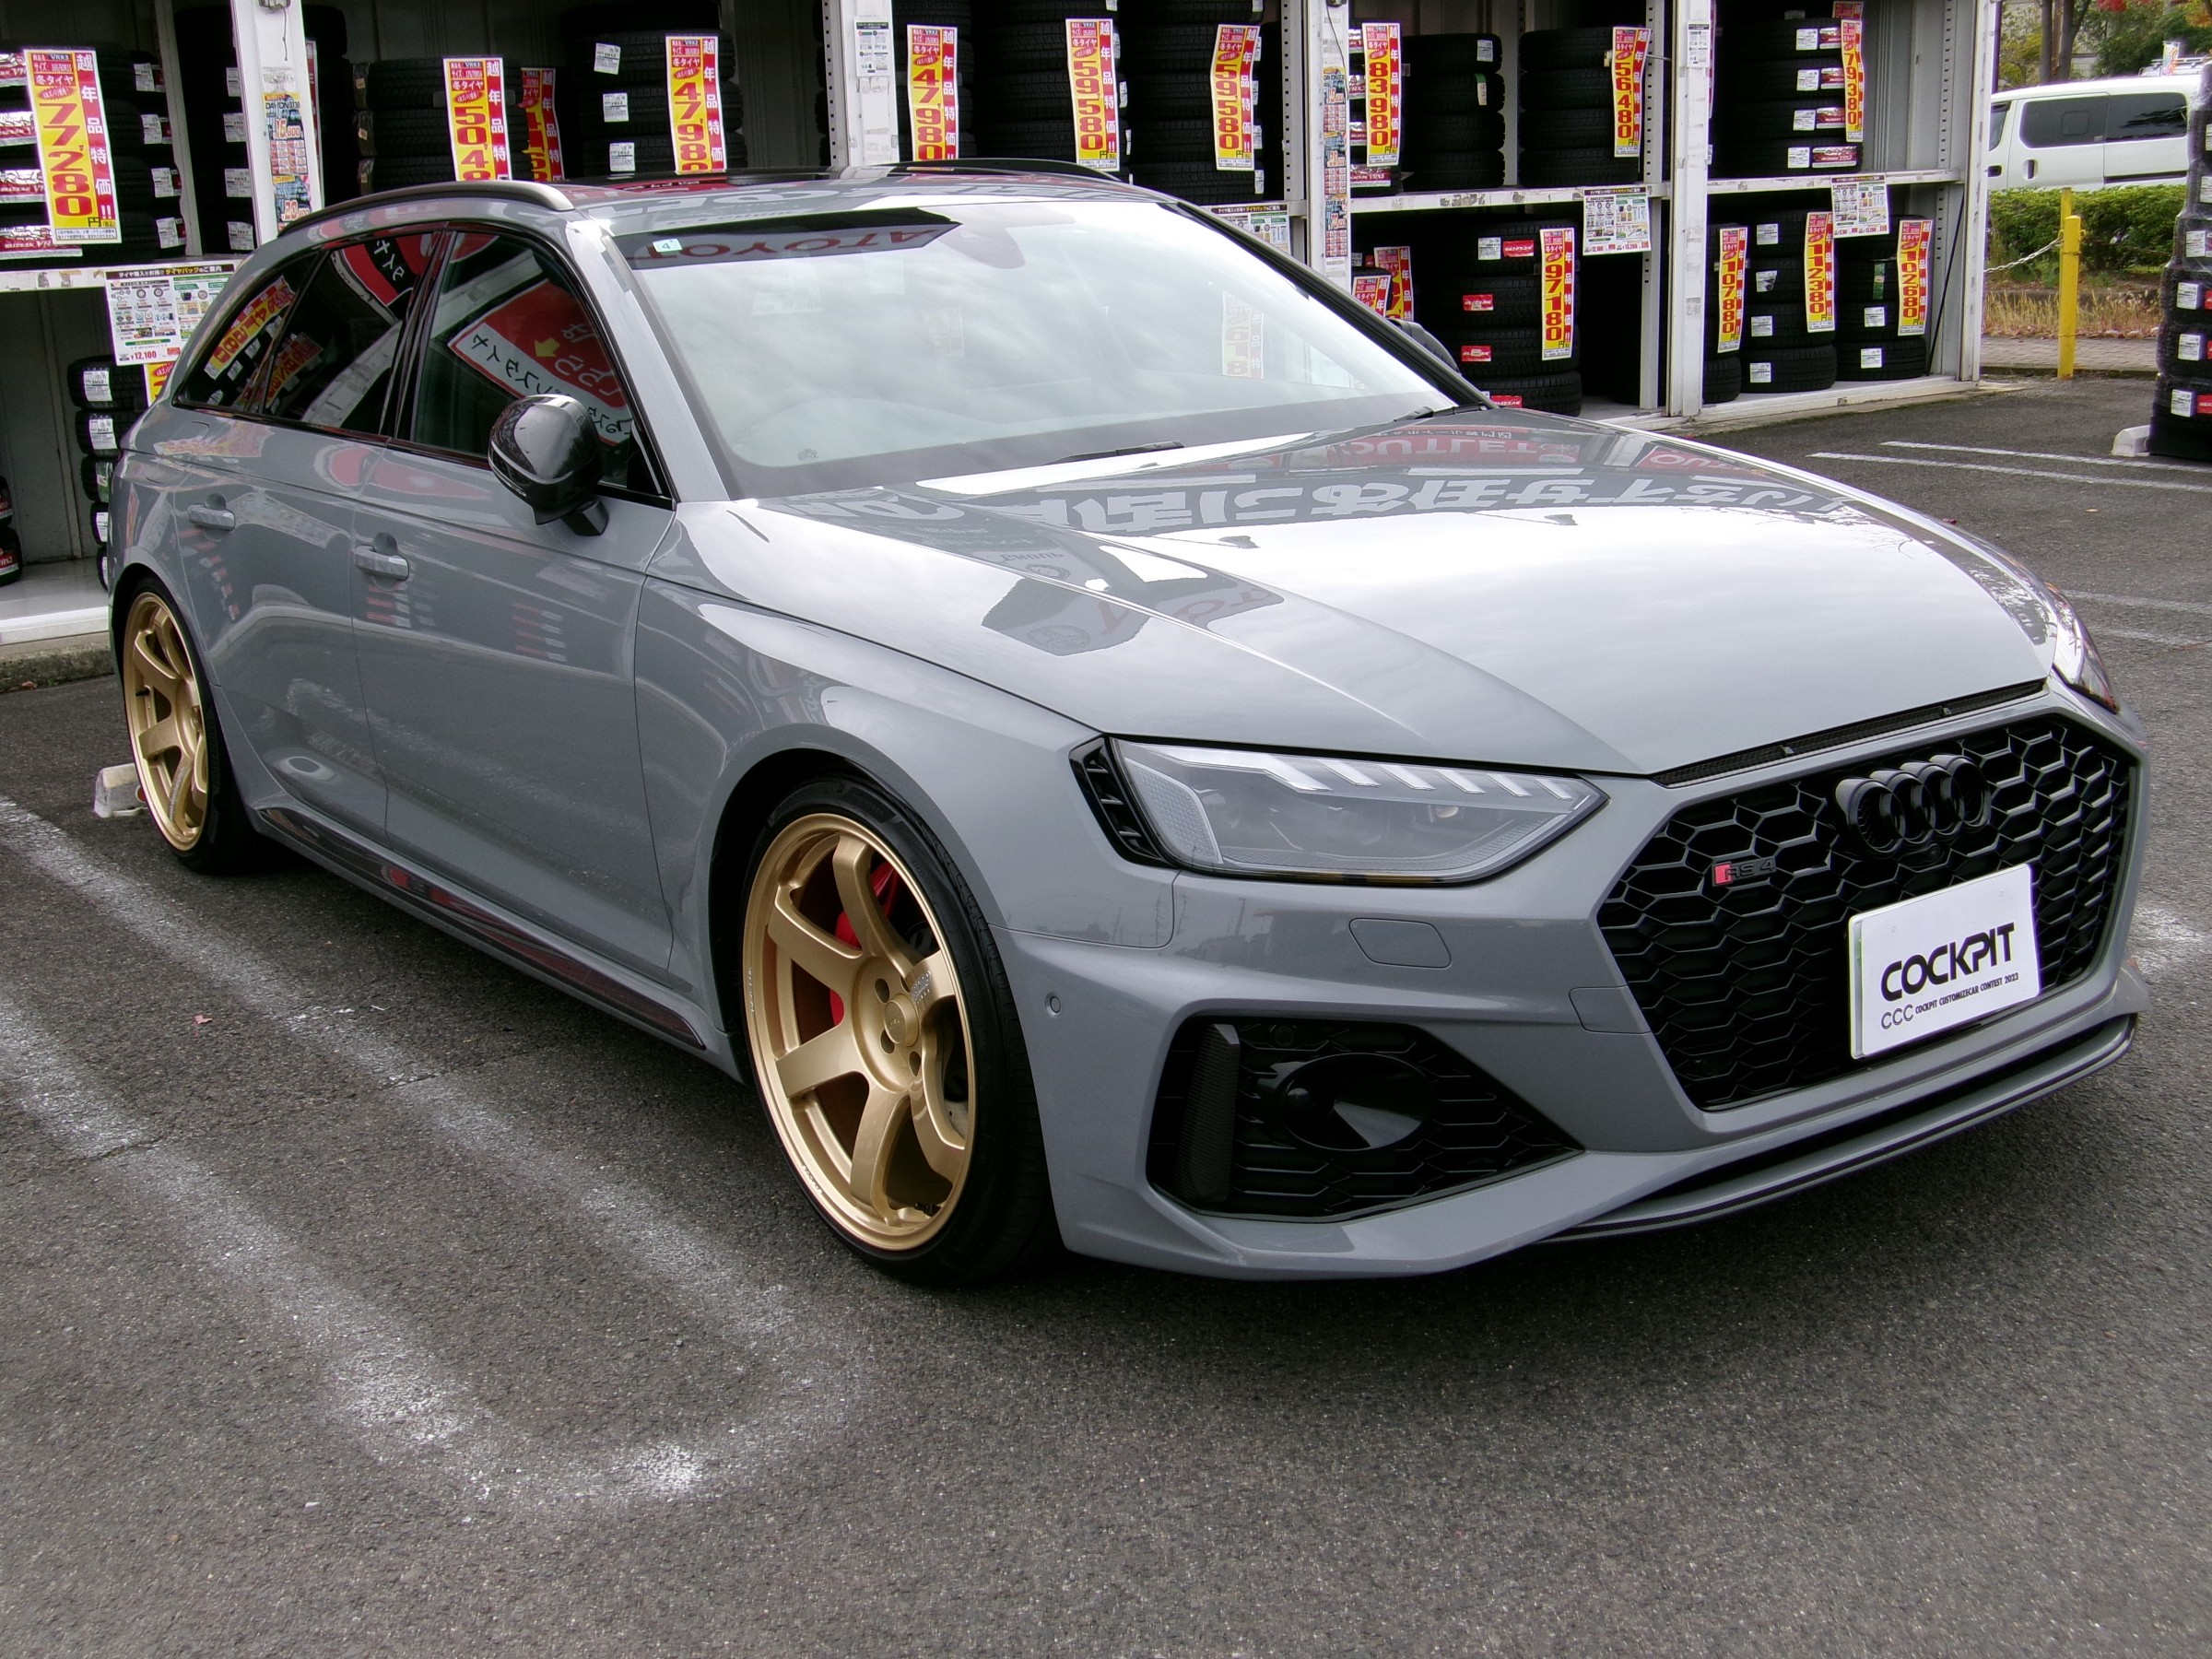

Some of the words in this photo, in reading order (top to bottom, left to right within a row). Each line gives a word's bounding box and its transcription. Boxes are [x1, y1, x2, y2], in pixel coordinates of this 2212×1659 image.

[1072, 38, 1097, 47] 冬タイヤ
[913, 46, 940, 55] 冬タイヤ
[673, 57, 700, 67] 冬タイヤ
[36, 75, 74, 86] 冬タイヤ
[453, 80, 484, 90] 冬タイヤ
[1880, 922, 2015, 1002] COCKPIT
[1880, 1004, 1914, 1030] CCC
[1915, 999, 1938, 1015] COCKPIT
[1939, 985, 1979, 1006] CUSTOMIZECAR
[1980, 977, 2003, 992] CONTEST
[2005, 972, 2019, 984] 2023
